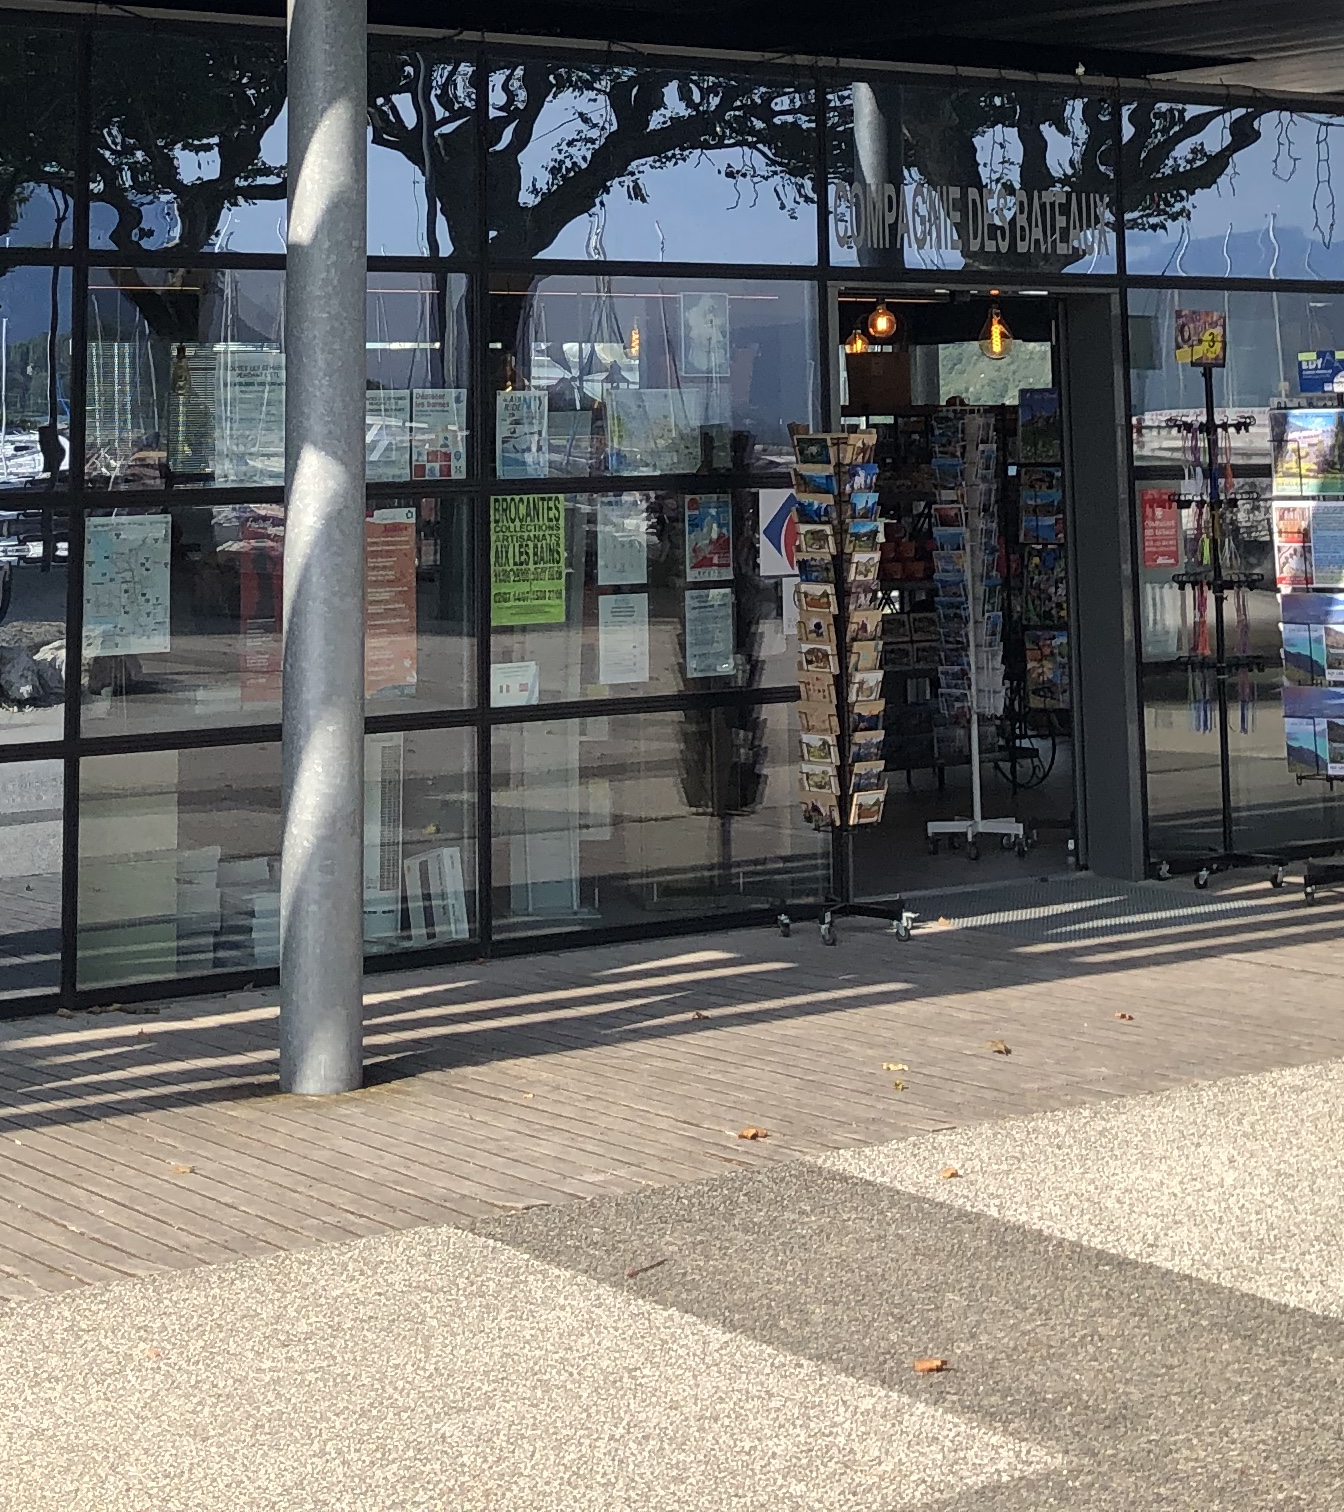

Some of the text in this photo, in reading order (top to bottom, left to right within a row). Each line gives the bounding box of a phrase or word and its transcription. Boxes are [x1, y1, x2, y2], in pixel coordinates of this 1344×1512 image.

[833, 181, 1110, 256] COMPAGNIE DES BATEAUX
[493, 496, 560, 524] BROCANTES
[494, 523, 561, 534] COLLECTIONS
[494, 533, 561, 543] ARTISANATS
[494, 542, 561, 567] AIX LES BAINS
